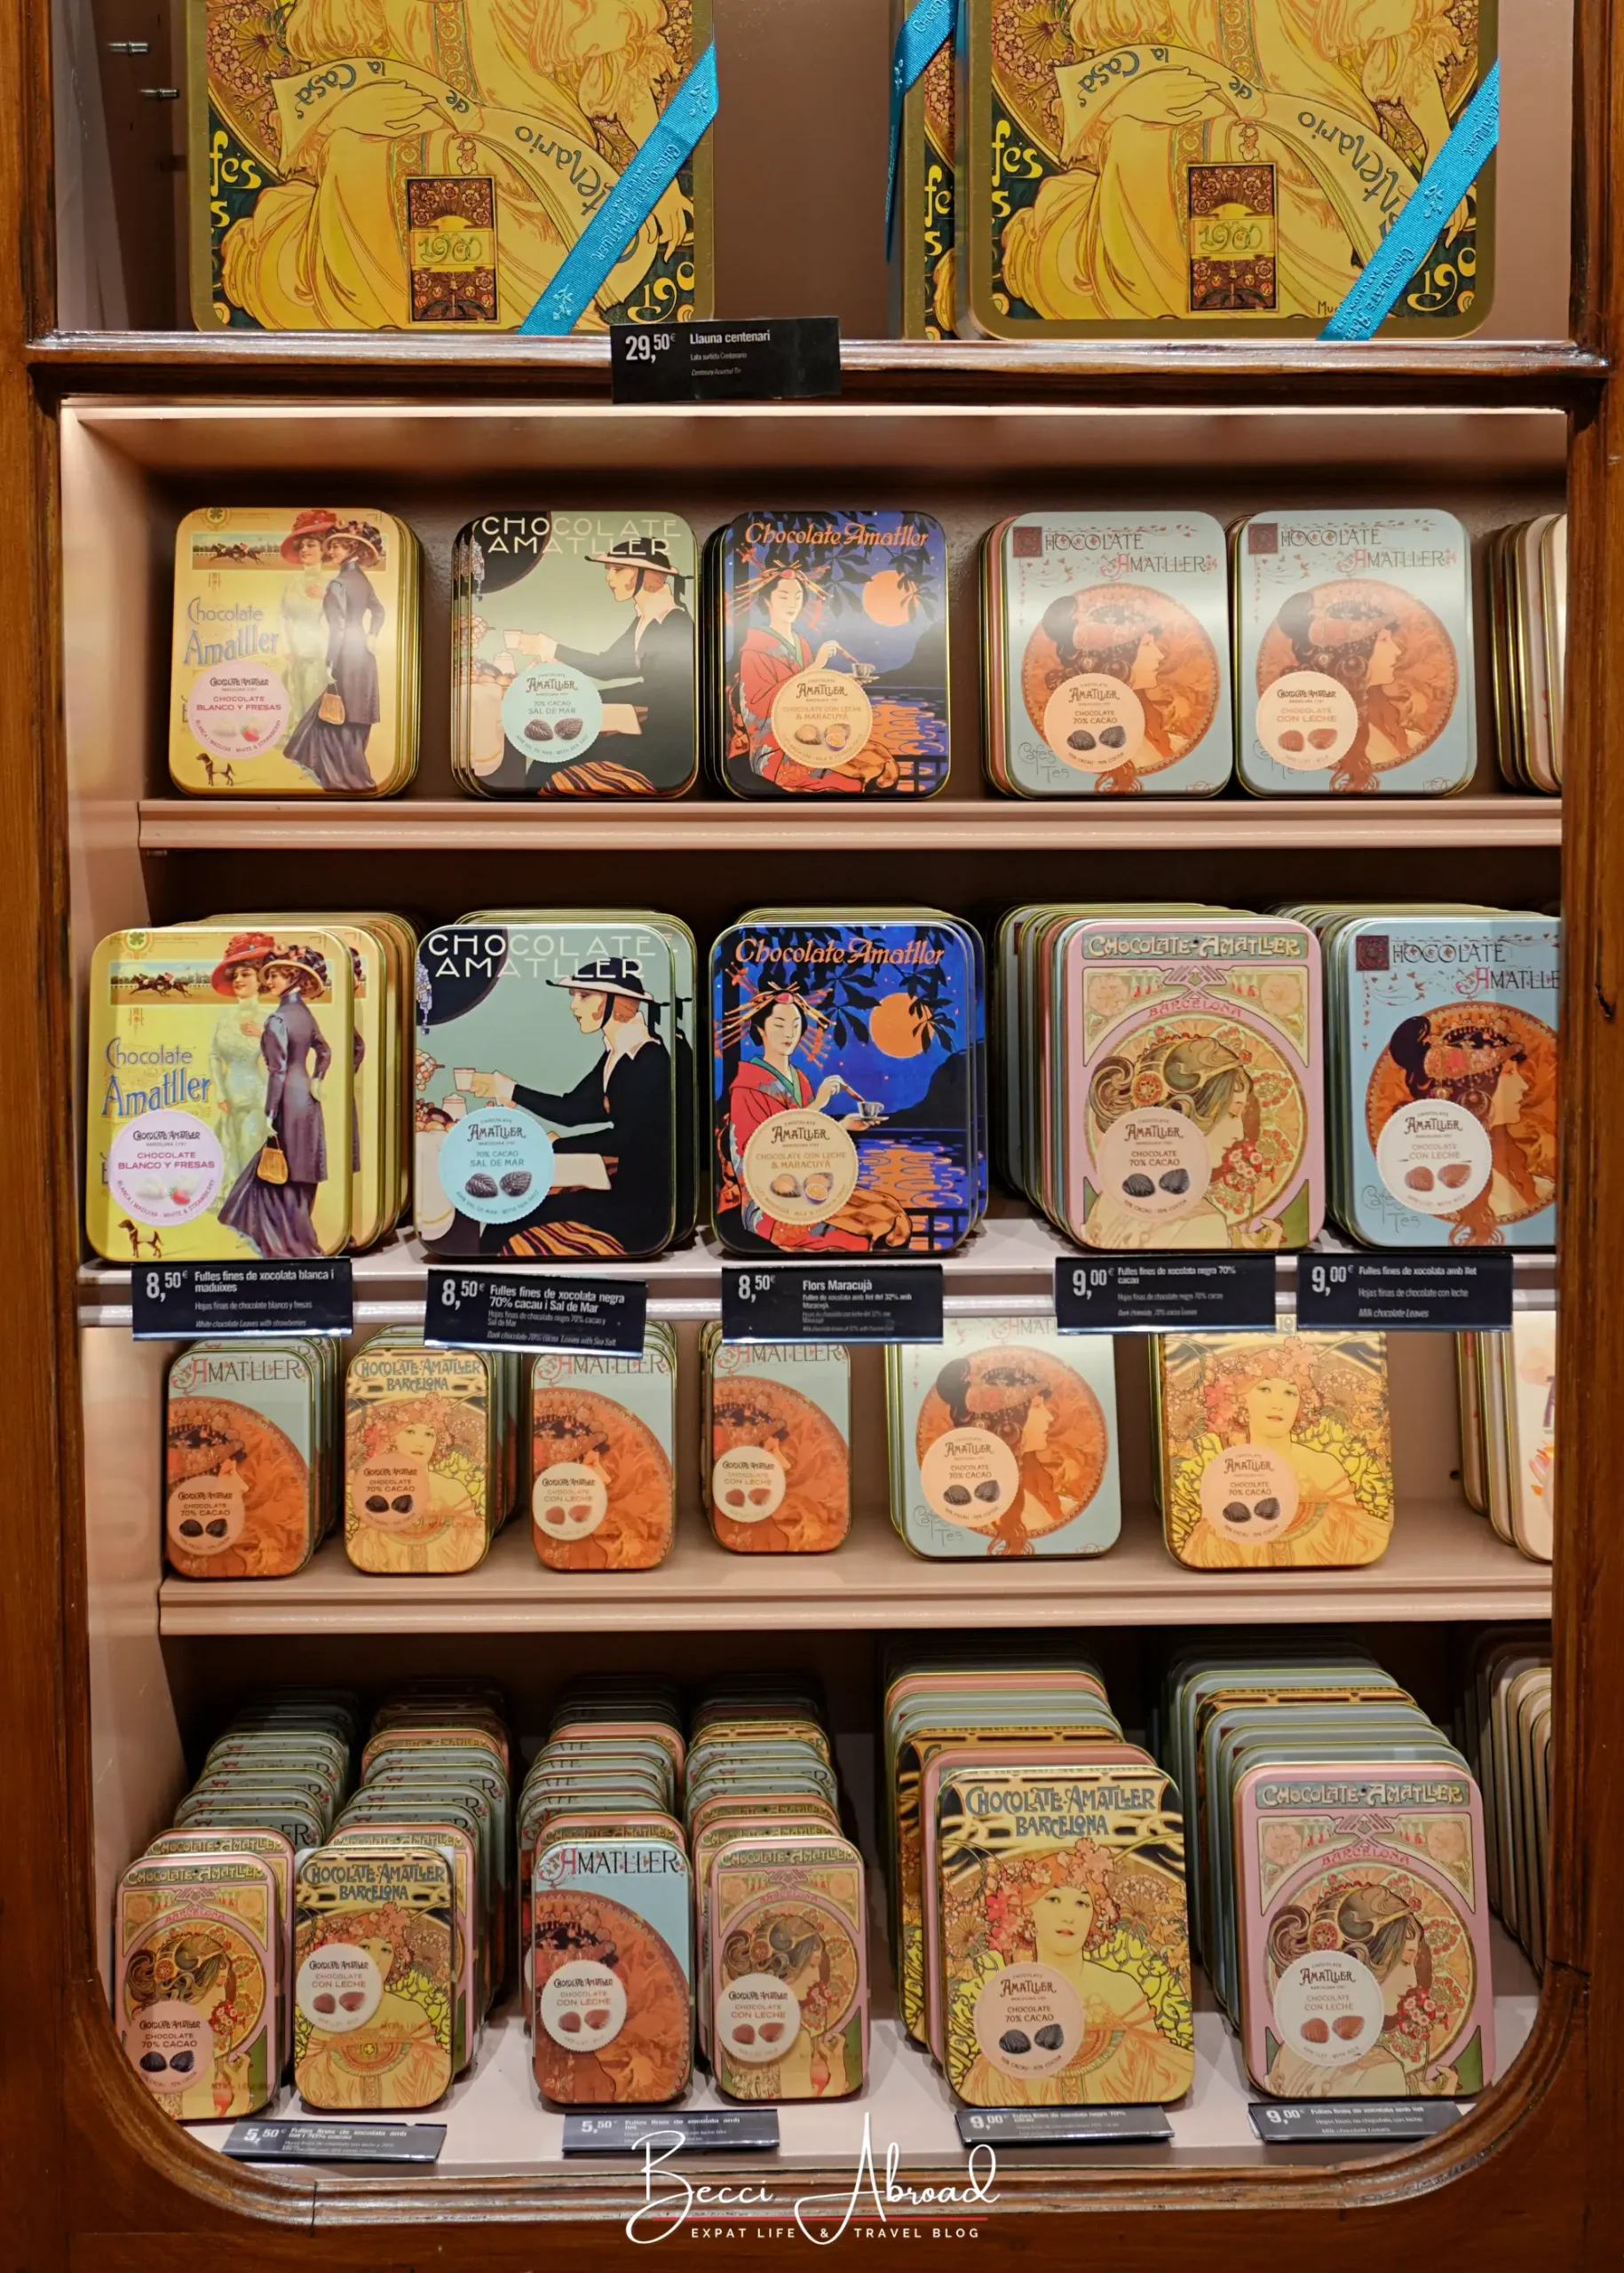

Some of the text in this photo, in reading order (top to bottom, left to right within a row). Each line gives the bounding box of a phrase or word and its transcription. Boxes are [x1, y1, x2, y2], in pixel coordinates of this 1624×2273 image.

[690, 329, 770, 345] Llauna centenari
[481, 516, 681, 536] CHOCOLATE
[745, 522, 929, 547] Chocolate Amatller
[487, 537, 671, 555] AMATLLER
[1117, 553, 1207, 573] AMATLLER
[1352, 548, 1446, 568] AMATLLER
[186, 597, 264, 625] Chocolate
[182, 623, 280, 665] Amatller
[428, 934, 656, 957] CHOCOLATE
[735, 937, 945, 965] Chocolate Amatller
[434, 957, 645, 978] AMATLLER
[1146, 998, 1242, 1019] BARCELONA
[105, 1037, 194, 1069] Chocolate
[100, 1066, 213, 1117] Amatller
[490, 1159, 503, 1168] DE
[504, 1158, 525, 1167] MAR
[1148, 1158, 1180, 1167] CACAO
[1409, 1151, 1461, 1160] CON LECHE
[117, 1161, 162, 1170] BLANCO
[174, 1160, 215, 1169] FRESAS
[194, 1271, 221, 1281] Fulles
[222, 1271, 244, 1281] fines
[246, 1270, 257, 1280] de
[259, 1270, 297, 1280] xocolata
[298, 1270, 329, 1279] blanca
[1218, 1266, 1236, 1275] 70%
[1359, 1266, 1381, 1275] Fulles
[1382, 1266, 1400, 1275] fines
[1402, 1266, 1412, 1275] de
[1414, 1266, 1445, 1275] xocolata
[1446, 1266, 1463, 1275] amb
[194, 1282, 237, 1293] maduixes
[490, 1285, 624, 1304] Fulles fines de xocolata negra
[803, 1279, 872, 1293] Flors Maracujà
[489, 1297, 513, 1308] 70%
[514, 1299, 543, 1311] cacau
[550, 1301, 565, 1311] Sal
[566, 1302, 578, 1312] de
[581, 1303, 599, 1313] Mar
[190, 1358, 301, 1383] AMATLLER
[385, 1377, 449, 1393] BARCELONA
[1016, 1814, 1110, 1839] BARCELONA
[559, 1847, 679, 1876] AMATLLER
[1321, 1847, 1411, 1865] BARCELONA
[339, 1886, 409, 1904] BARCELONA
[580, 1997, 612, 2006] LECHE
[1303, 2001, 1354, 2011] CON LECHE
[1306, 1993, 1350, 2002] CHOCOLATE
[1005, 2013, 1055, 2023] 70% CACAO
[142, 2039, 198, 2049] 70% CACAO
